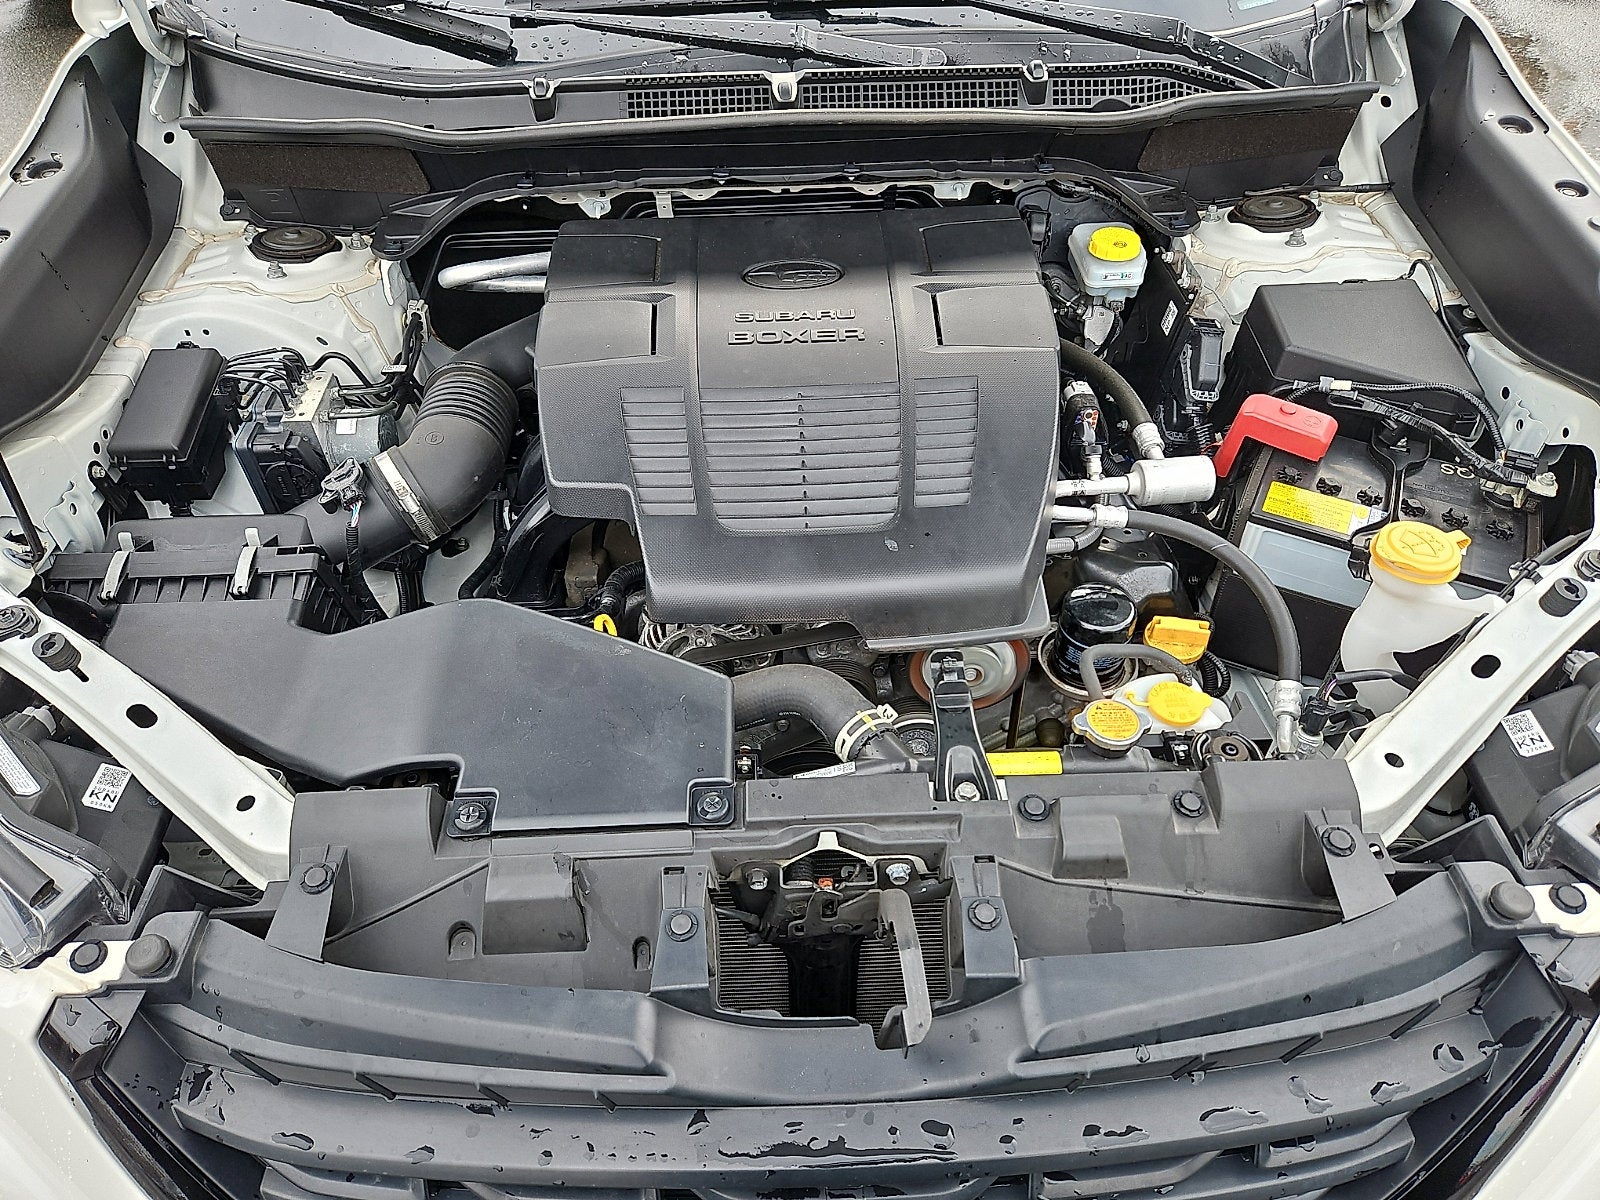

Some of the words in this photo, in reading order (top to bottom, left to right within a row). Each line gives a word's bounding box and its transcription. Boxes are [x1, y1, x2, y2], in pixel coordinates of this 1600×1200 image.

[735, 308, 856, 323] SUBARU
[728, 327, 866, 346] BOXER
[1516, 735, 1544, 749] KN
[89, 790, 117, 803] KN
